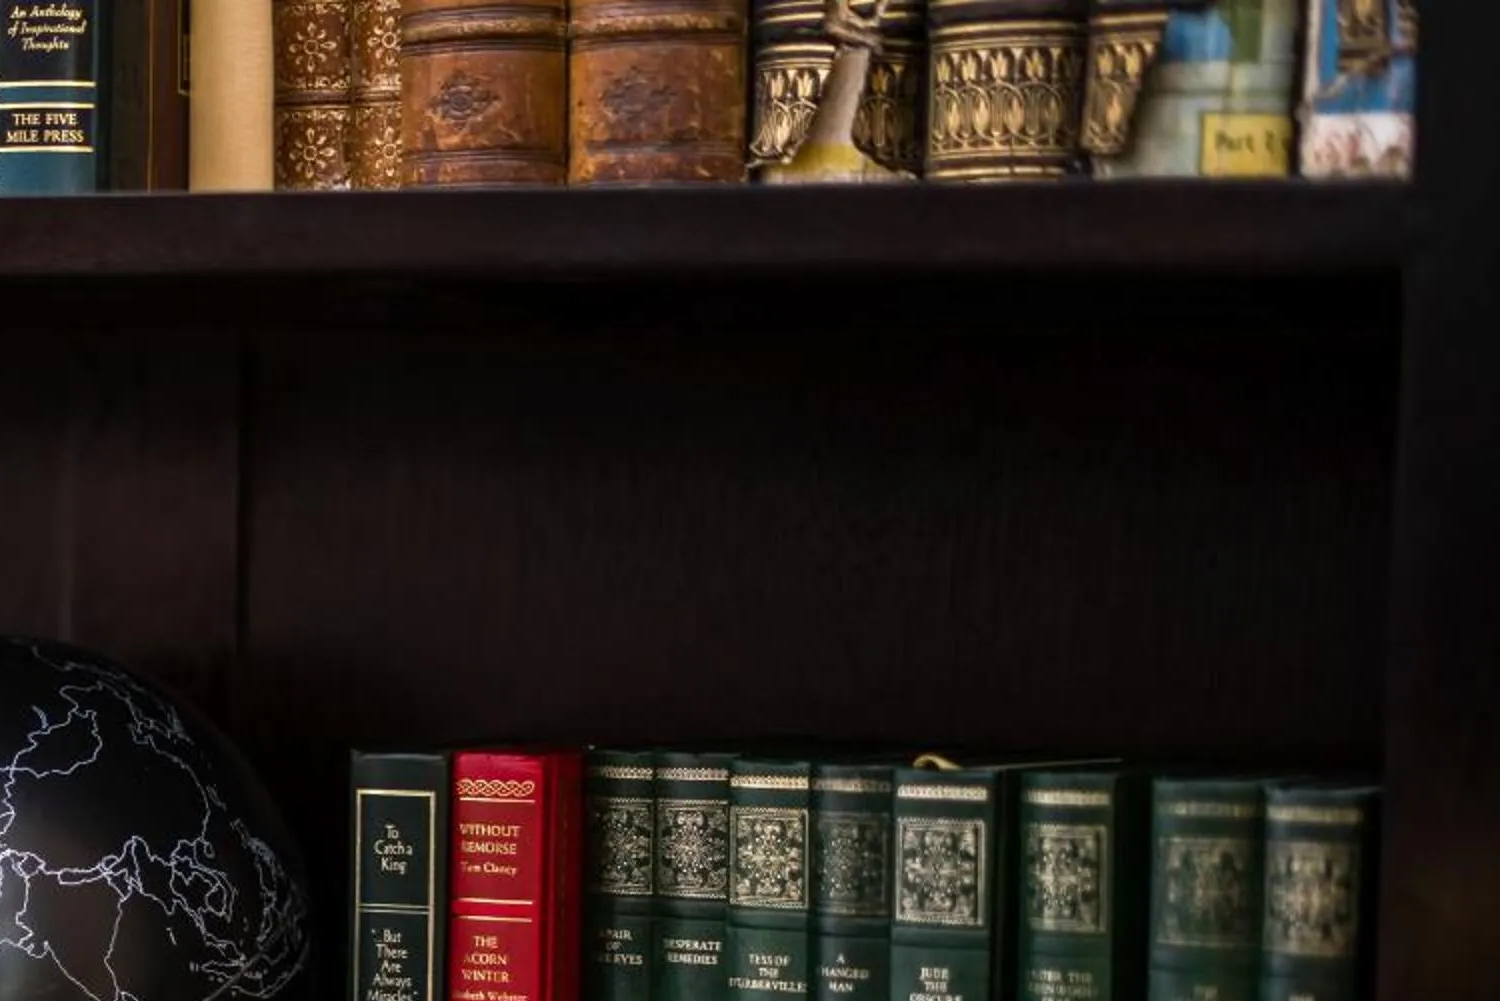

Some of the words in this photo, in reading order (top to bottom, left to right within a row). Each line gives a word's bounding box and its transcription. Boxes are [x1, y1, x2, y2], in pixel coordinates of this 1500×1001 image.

[11, 5, 27, 19] An
[29, 3, 82, 21] Anthology
[7, 19, 20, 38] of
[21, 20, 88, 36] Inspirational
[22, 36, 70, 52] Thoughts
[11, 112, 41, 126] THE
[45, 112, 77, 126] FIVE
[5, 129, 39, 143] MILE
[43, 129, 85, 143] PRESS
[384, 823, 399, 839] To
[373, 839, 405, 856] Catch
[381, 857, 408, 875] King
[472, 935, 499, 949] THE
[375, 943, 409, 960] There
[835, 953, 846, 964] A
[381, 959, 404, 973] Are
[749, 953, 772, 966] TESS
[774, 955, 791, 967] OF
[461, 969, 509, 984] WINTER
[757, 967, 780, 979] THE
[919, 967, 950, 981] JUDE
[371, 972, 414, 996] Always
[828, 980, 854, 993] MAN
[924, 981, 949, 993] THE
